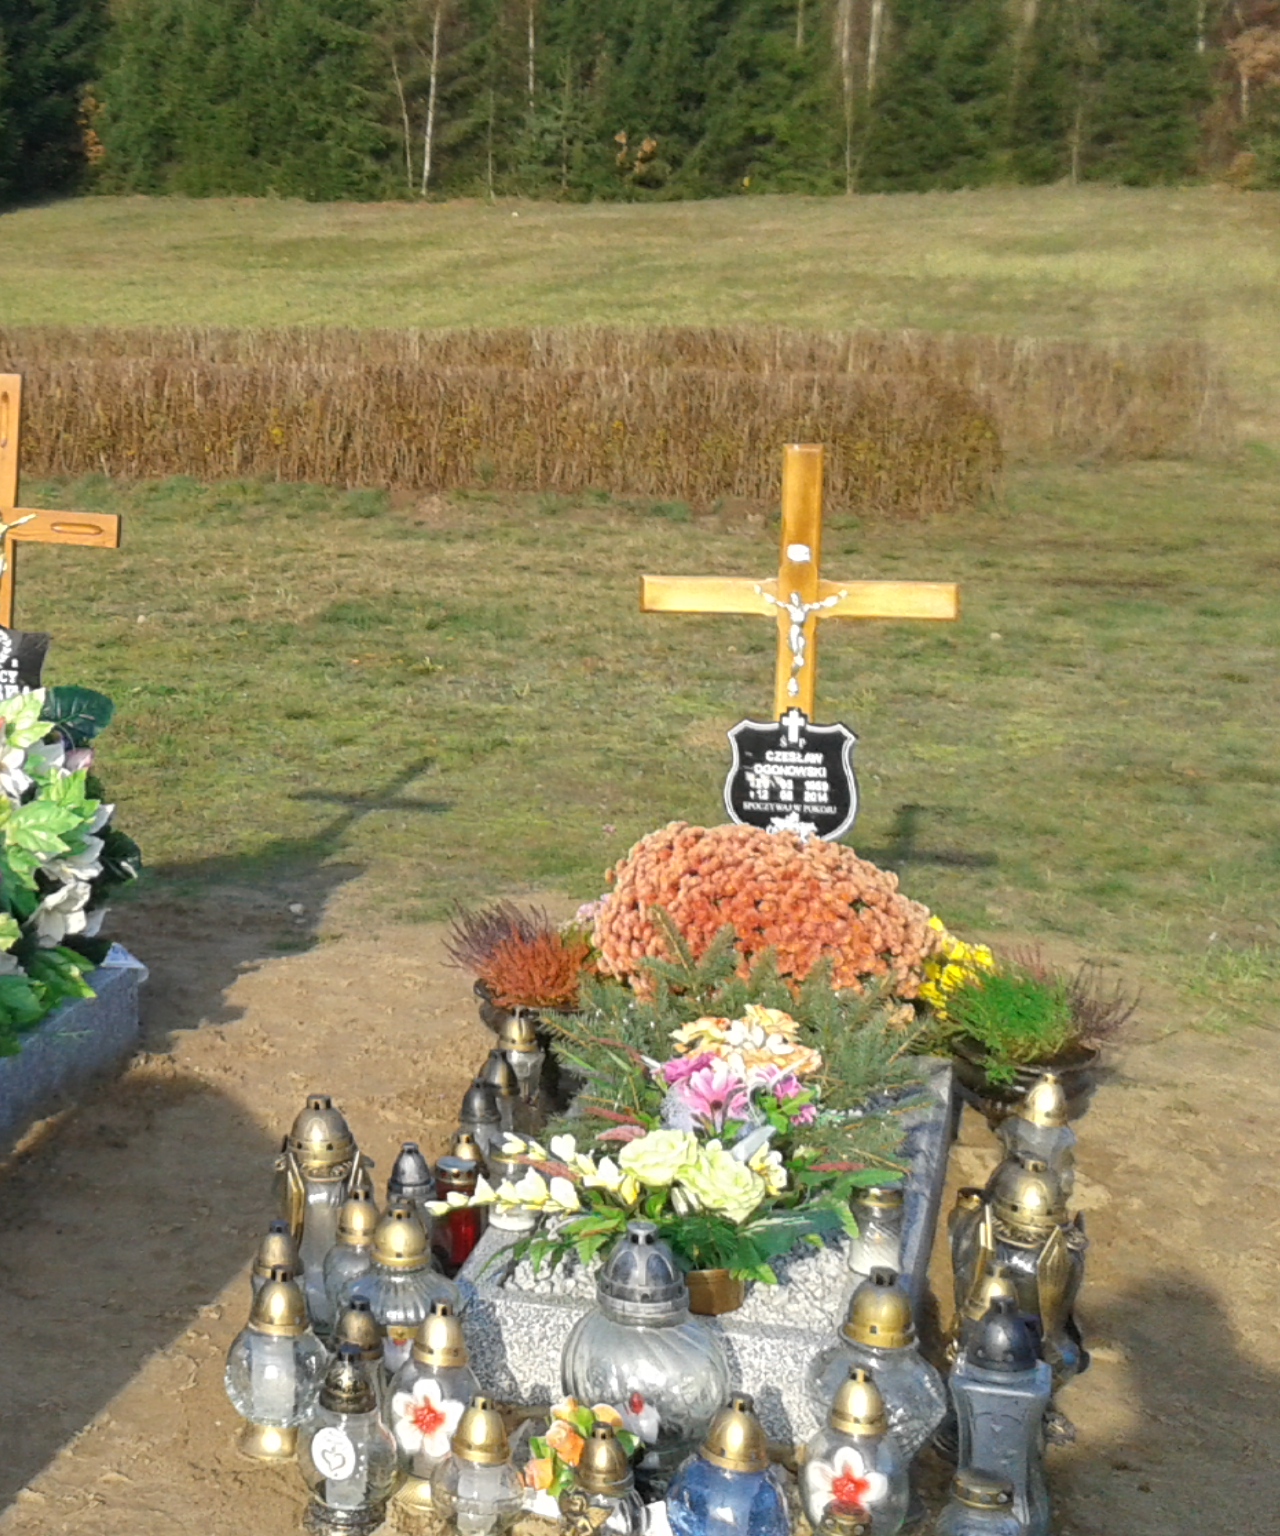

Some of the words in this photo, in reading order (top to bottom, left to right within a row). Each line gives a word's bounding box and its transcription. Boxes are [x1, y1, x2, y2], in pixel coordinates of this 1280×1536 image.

[765, 750, 824, 764] CZESŁAW
[753, 764, 827, 778] OGONOWSKI
[804, 791, 828, 804] 2014
[743, 801, 792, 813] SPOCZYWAJ
